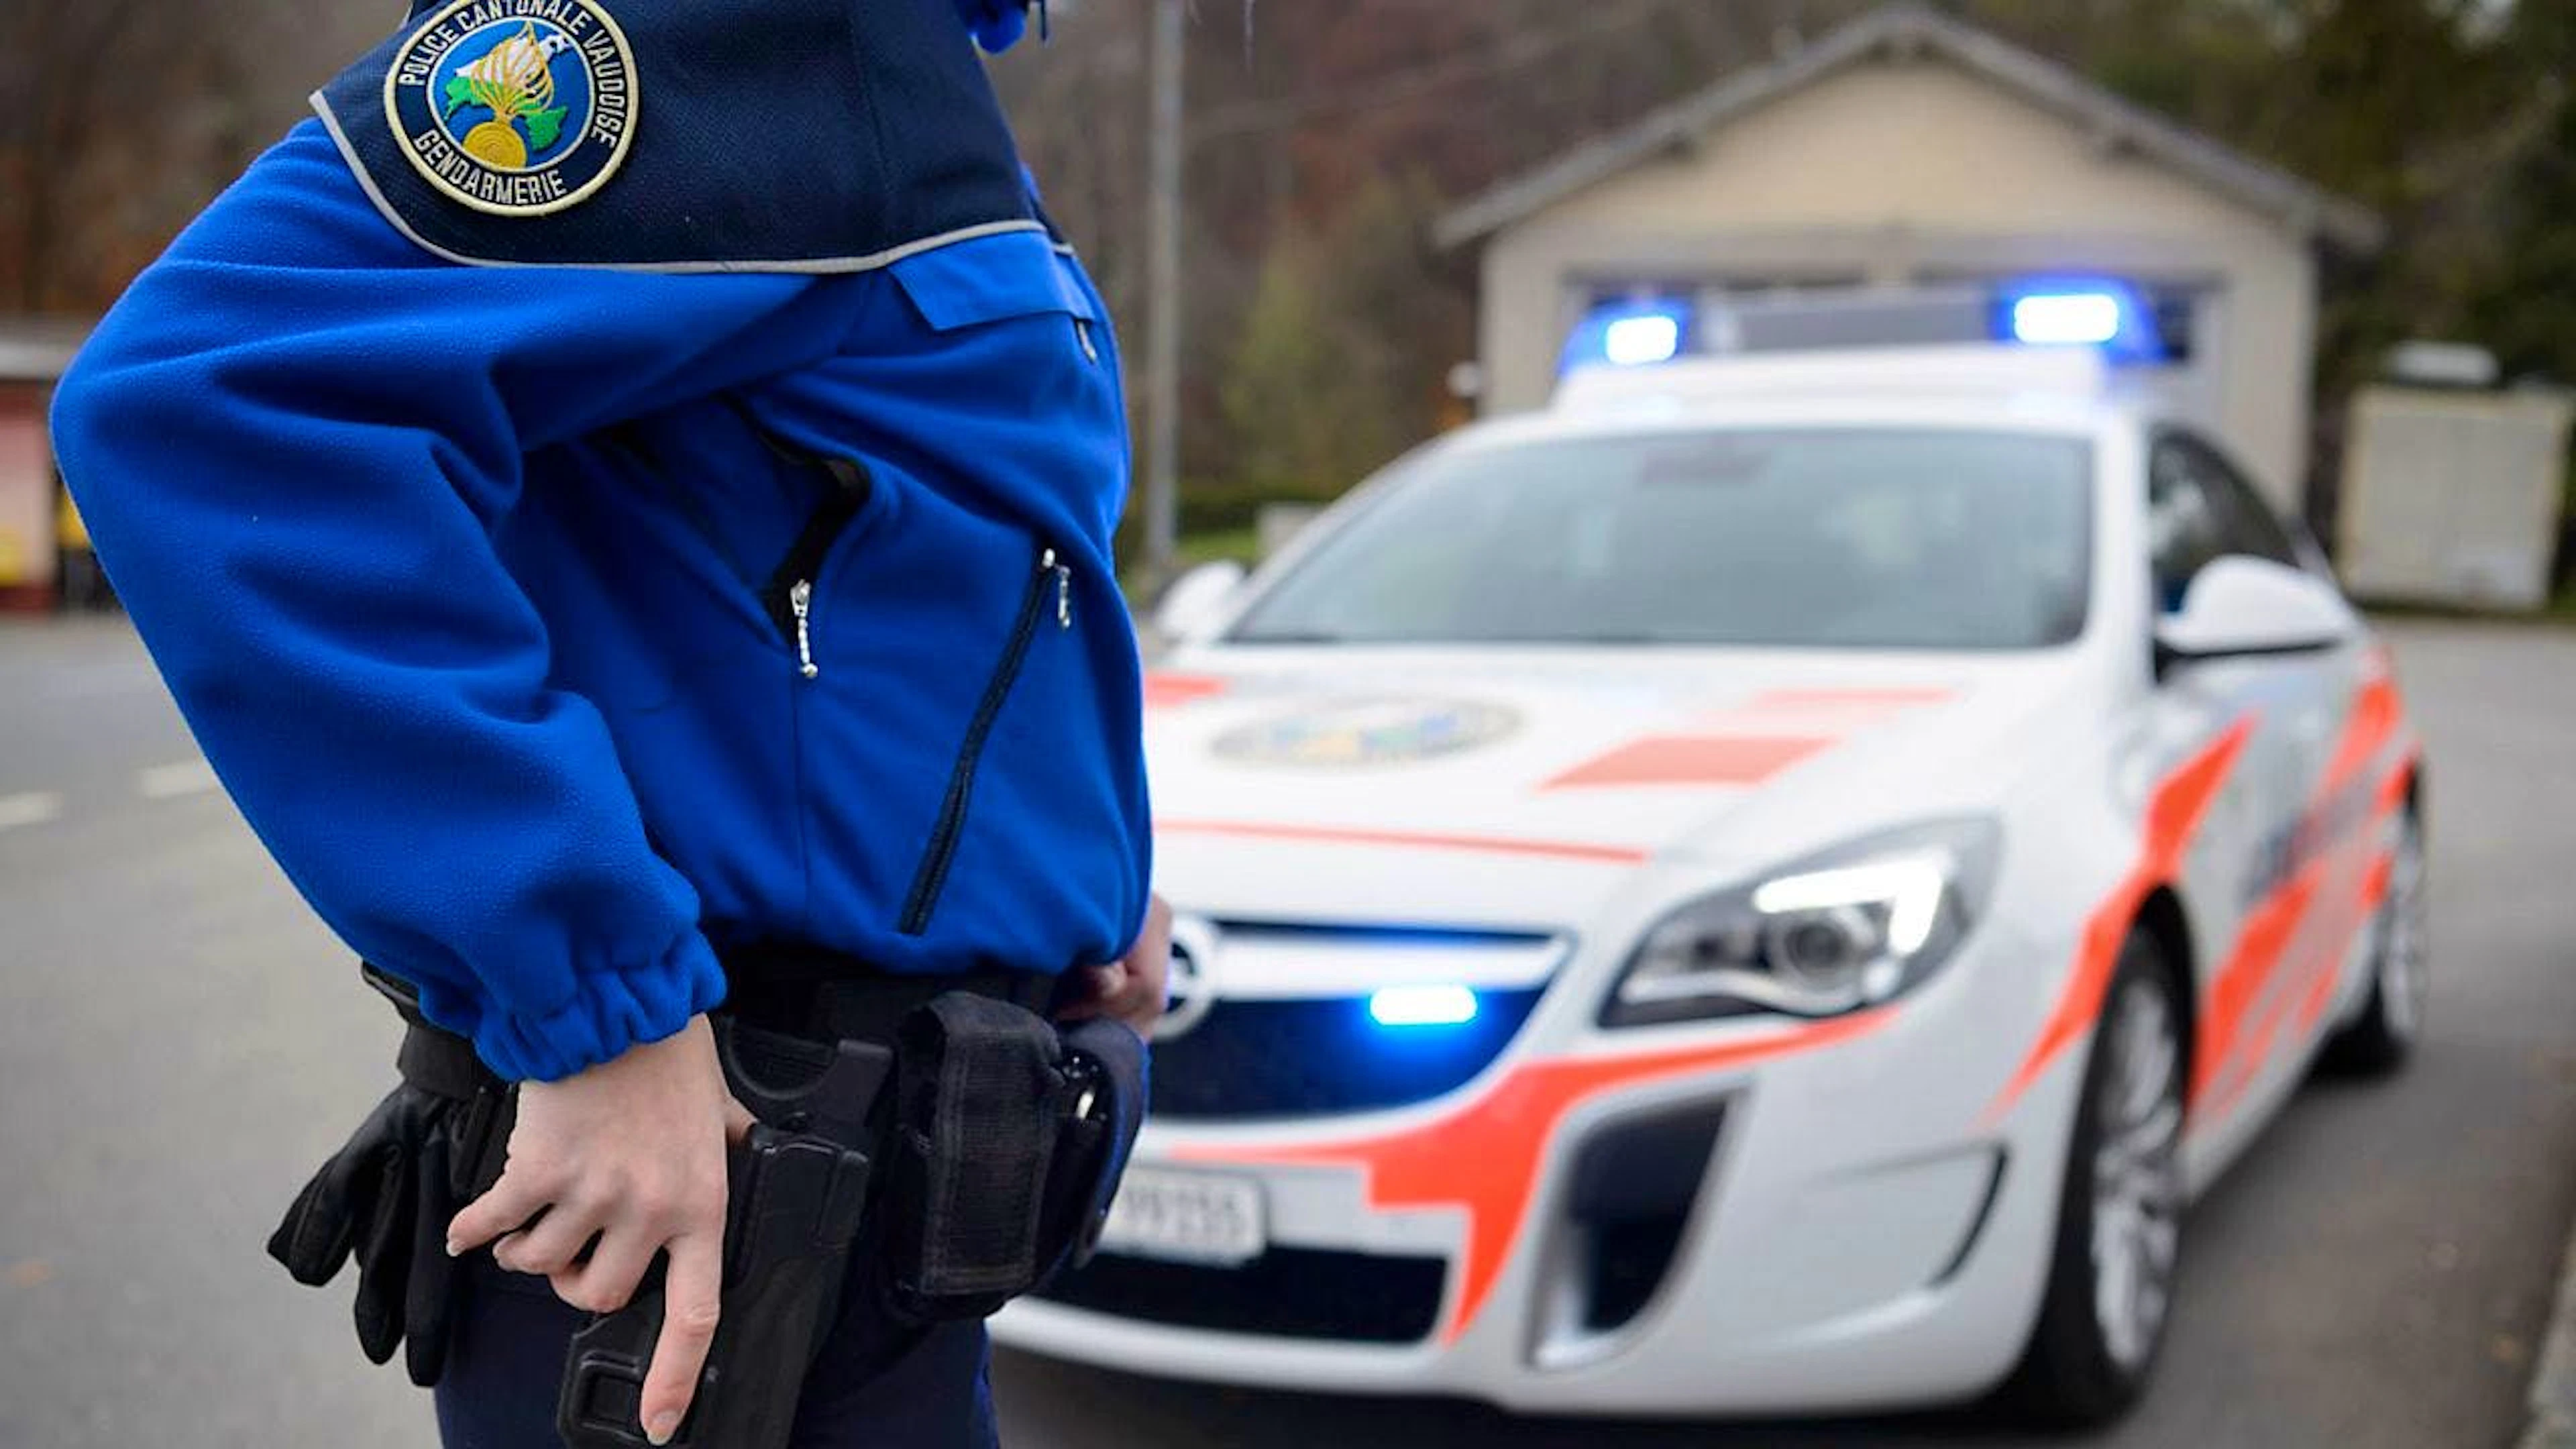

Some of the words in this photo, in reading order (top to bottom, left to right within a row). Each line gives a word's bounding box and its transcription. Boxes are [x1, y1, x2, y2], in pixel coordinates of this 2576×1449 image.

[398, 23, 460, 86] POLICE
[582, 30, 625, 148] VAUDOISE
[413, 129, 567, 204] GENDARMERIE
